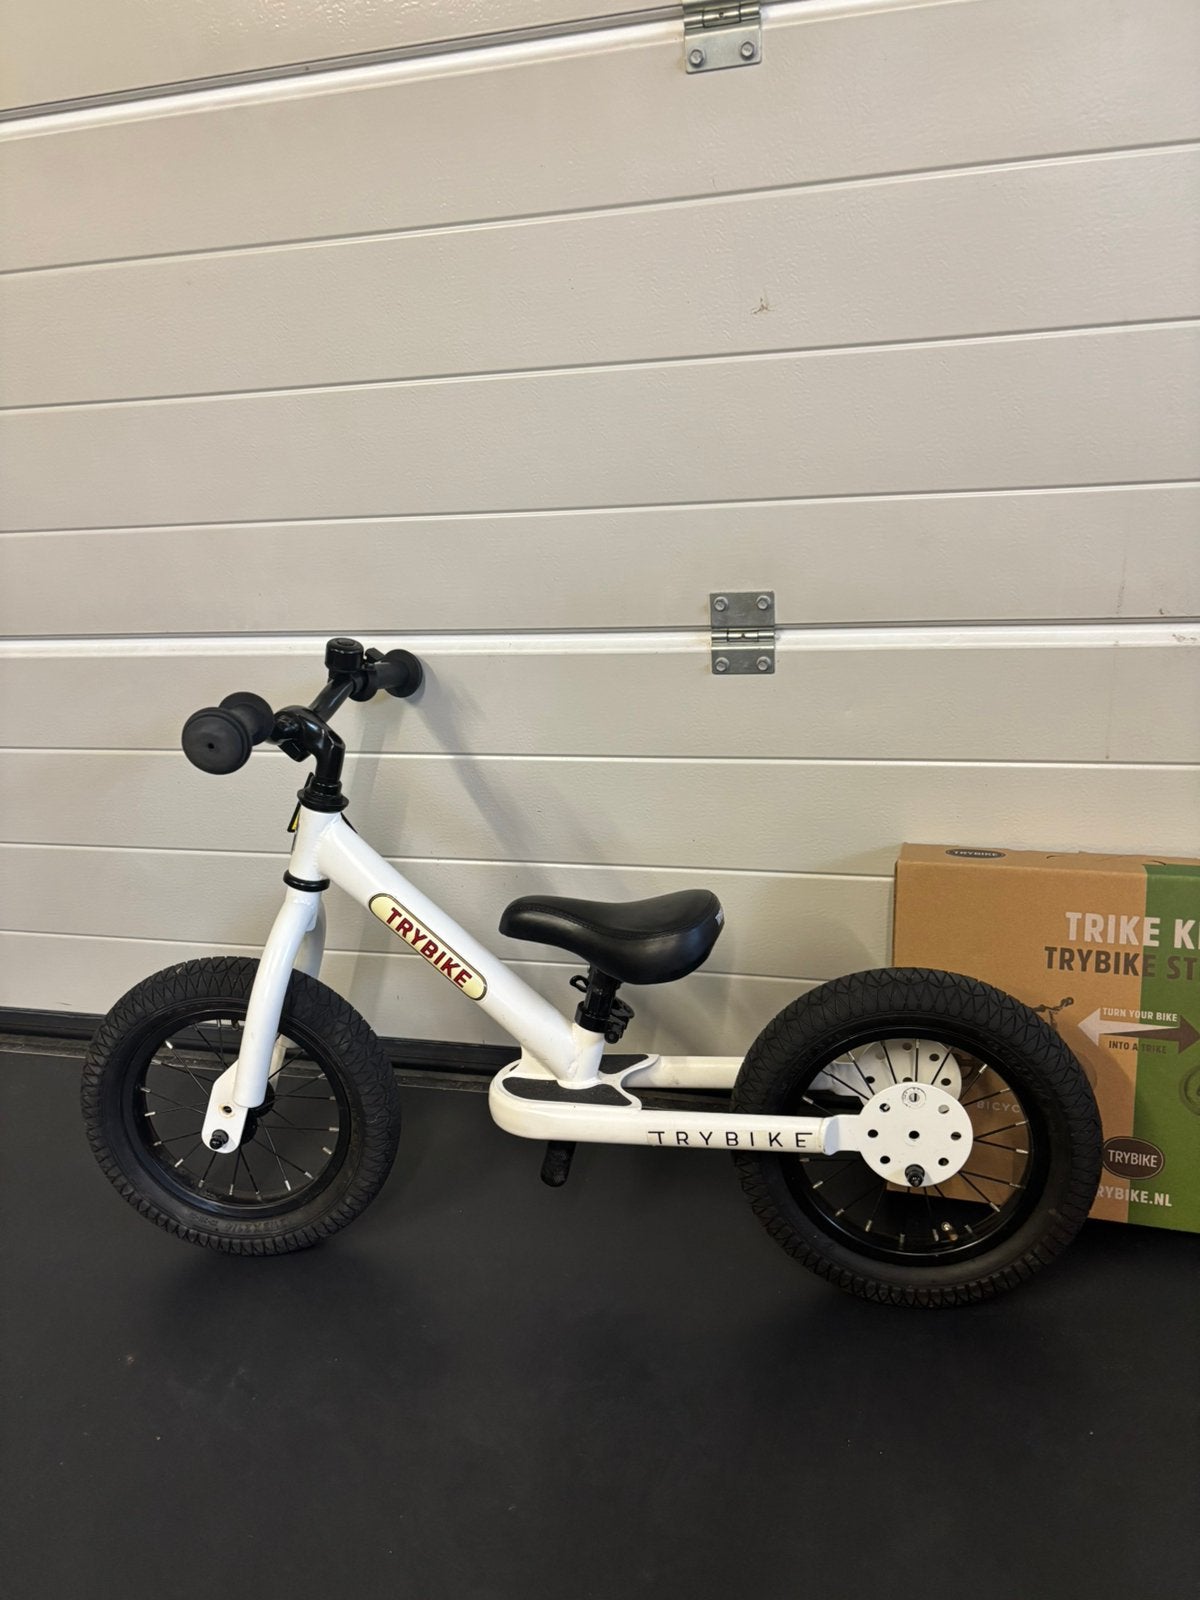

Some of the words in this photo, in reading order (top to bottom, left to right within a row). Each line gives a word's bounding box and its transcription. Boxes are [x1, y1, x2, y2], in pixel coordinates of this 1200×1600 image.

[1065, 911, 1161, 947] TRIKE
[1174, 918, 1200, 950] K
[386, 907, 473, 988] TRYBIKE
[1044, 946, 1156, 978] TRYBIKE
[1166, 955, 1200, 981] ST
[1103, 1007, 1127, 1017] TURN
[1129, 1009, 1154, 1020] YOUR
[1155, 1012, 1178, 1022] BIKE
[1108, 1040, 1130, 1050] INTO
[1132, 1043, 1138, 1051] A
[1142, 1043, 1167, 1054] TRIKE
[976, 1101, 1021, 1113] BICYC
[647, 1130, 813, 1148] TRYBIKE
[1107, 1149, 1158, 1168] TRYBIKE
[1097, 1185, 1173, 1207] RYBIKE.NL
